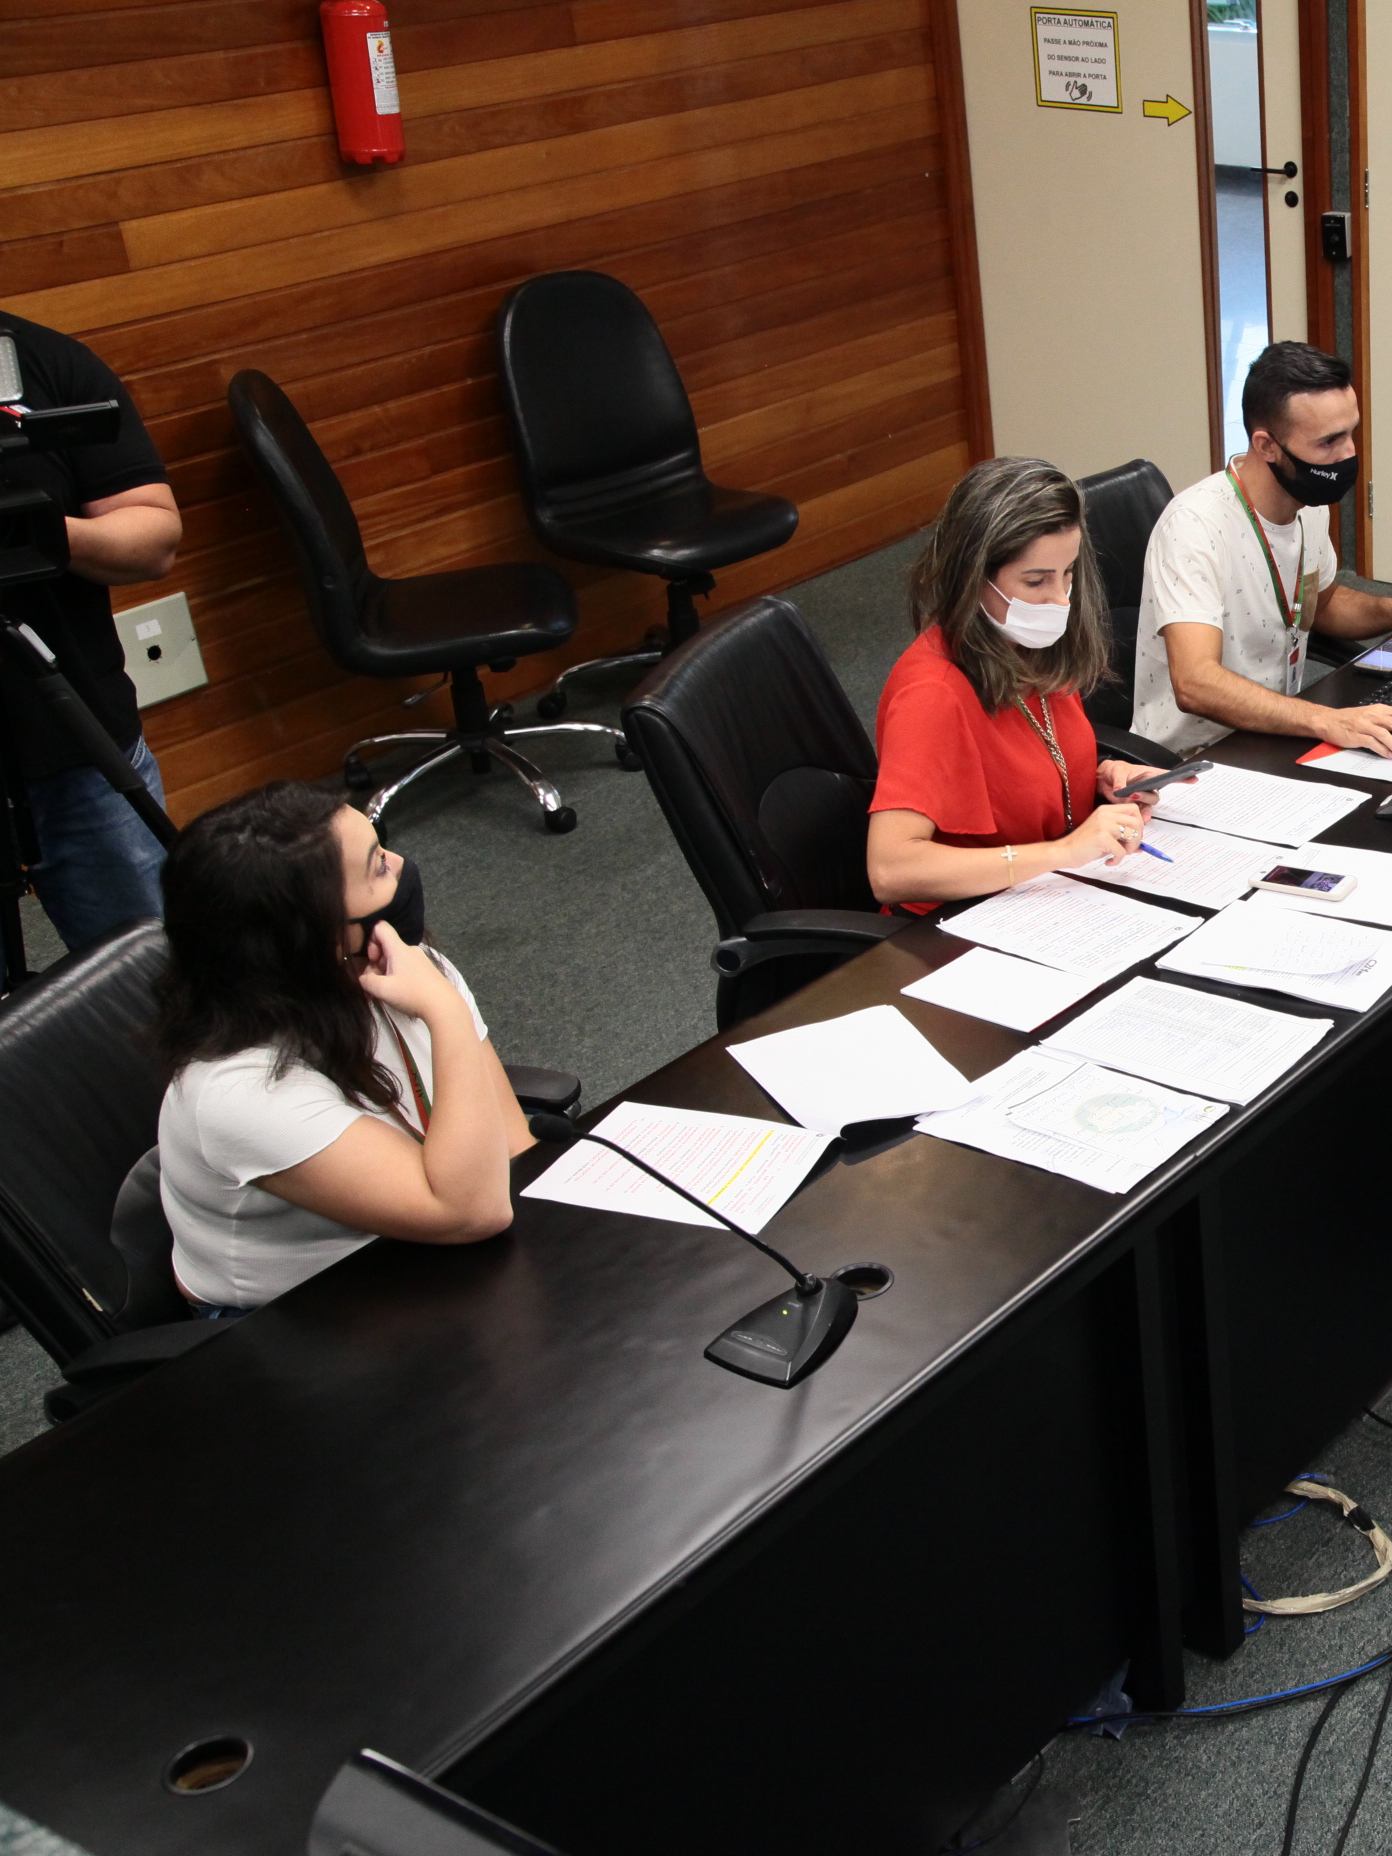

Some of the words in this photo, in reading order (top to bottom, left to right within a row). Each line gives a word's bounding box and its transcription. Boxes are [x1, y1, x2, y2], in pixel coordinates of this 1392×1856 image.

[1037, 16, 1061, 26] PORTA
[1063, 18, 1112, 29] AUTOMÁTICA
[1082, 40, 1108, 48] PRÓXIMA
[1310, 468, 1331, 479] Hurley
